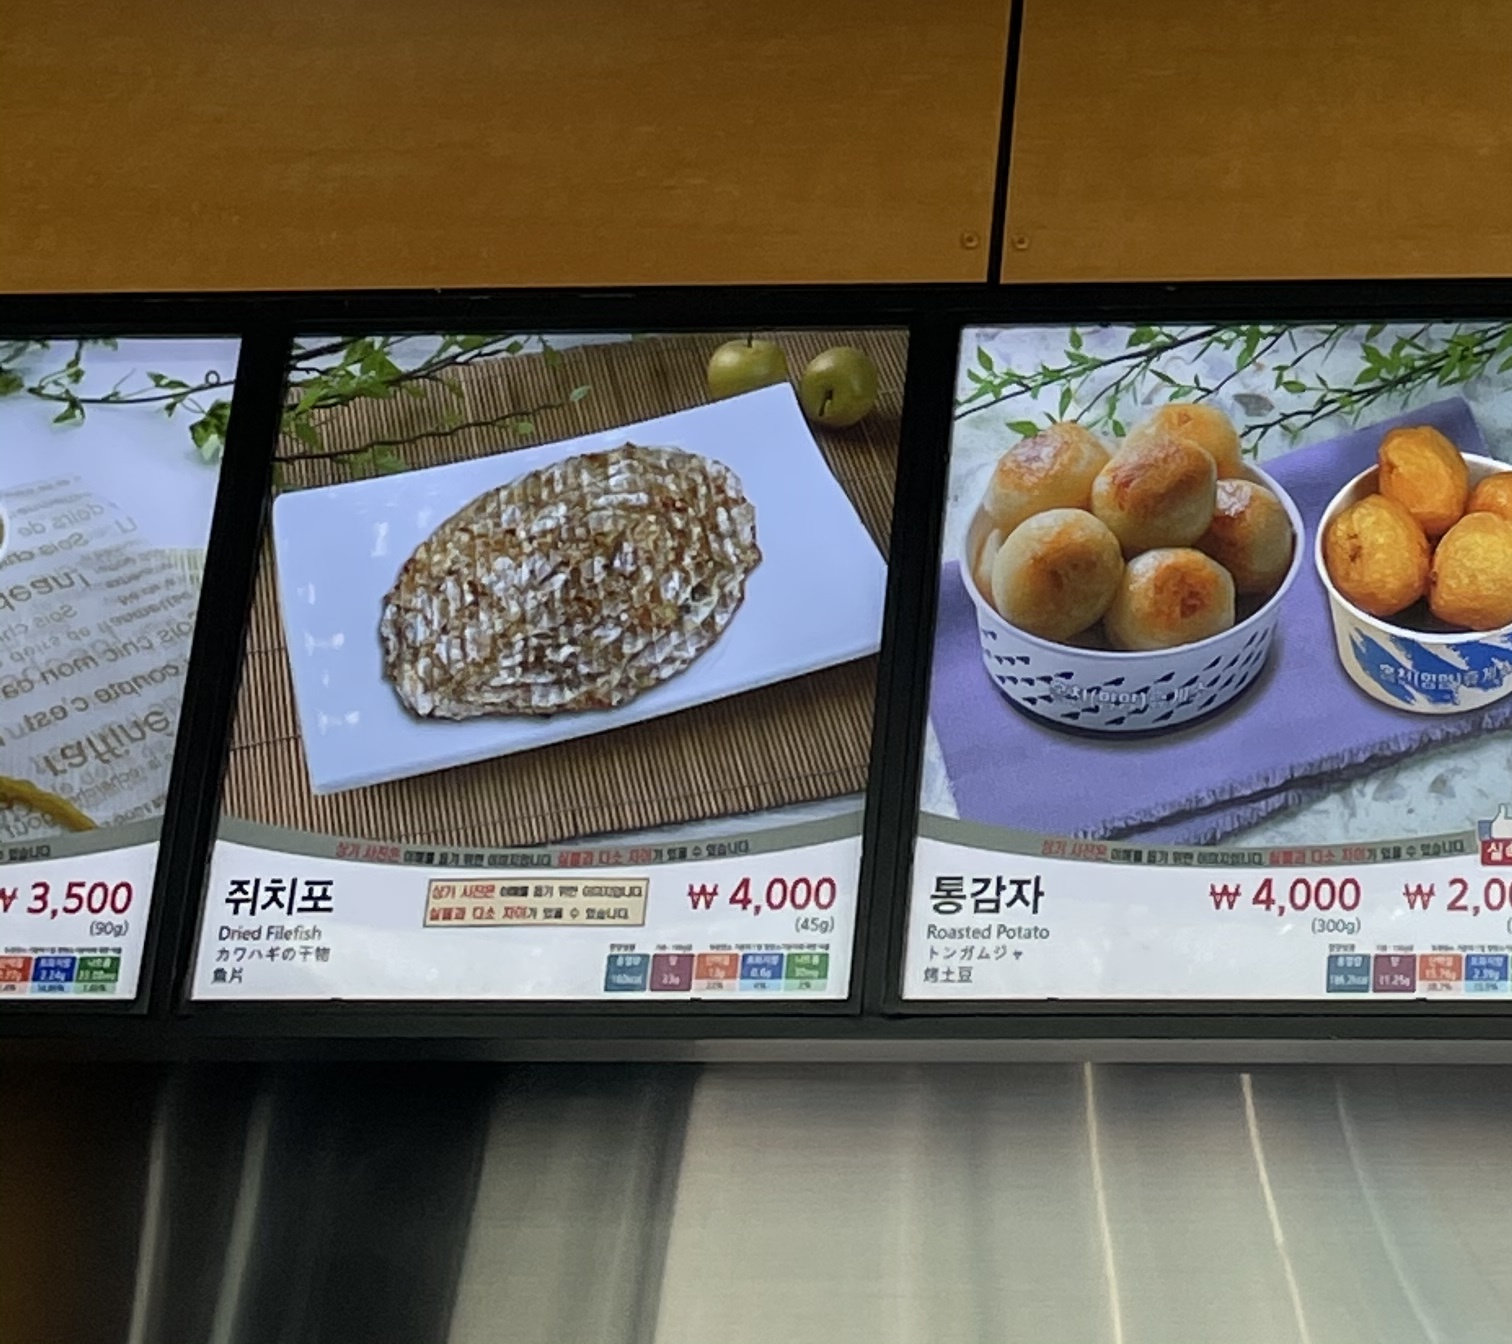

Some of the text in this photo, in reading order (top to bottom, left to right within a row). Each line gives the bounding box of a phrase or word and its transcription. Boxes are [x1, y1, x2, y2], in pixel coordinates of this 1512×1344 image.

[27, 881, 133, 920] 3,500
[224, 876, 334, 917] 쥐치포
[729, 876, 838, 917] 4,000
[929, 874, 1046, 915] 통감자
[1252, 877, 1362, 917] 4,000
[89, 919, 130, 937] (90g)
[218, 923, 322, 942] Dried Filefish
[794, 915, 835, 934] (45g)
[926, 923, 1050, 940] Roasted Potato
[1310, 917, 1362, 935] (300g)
